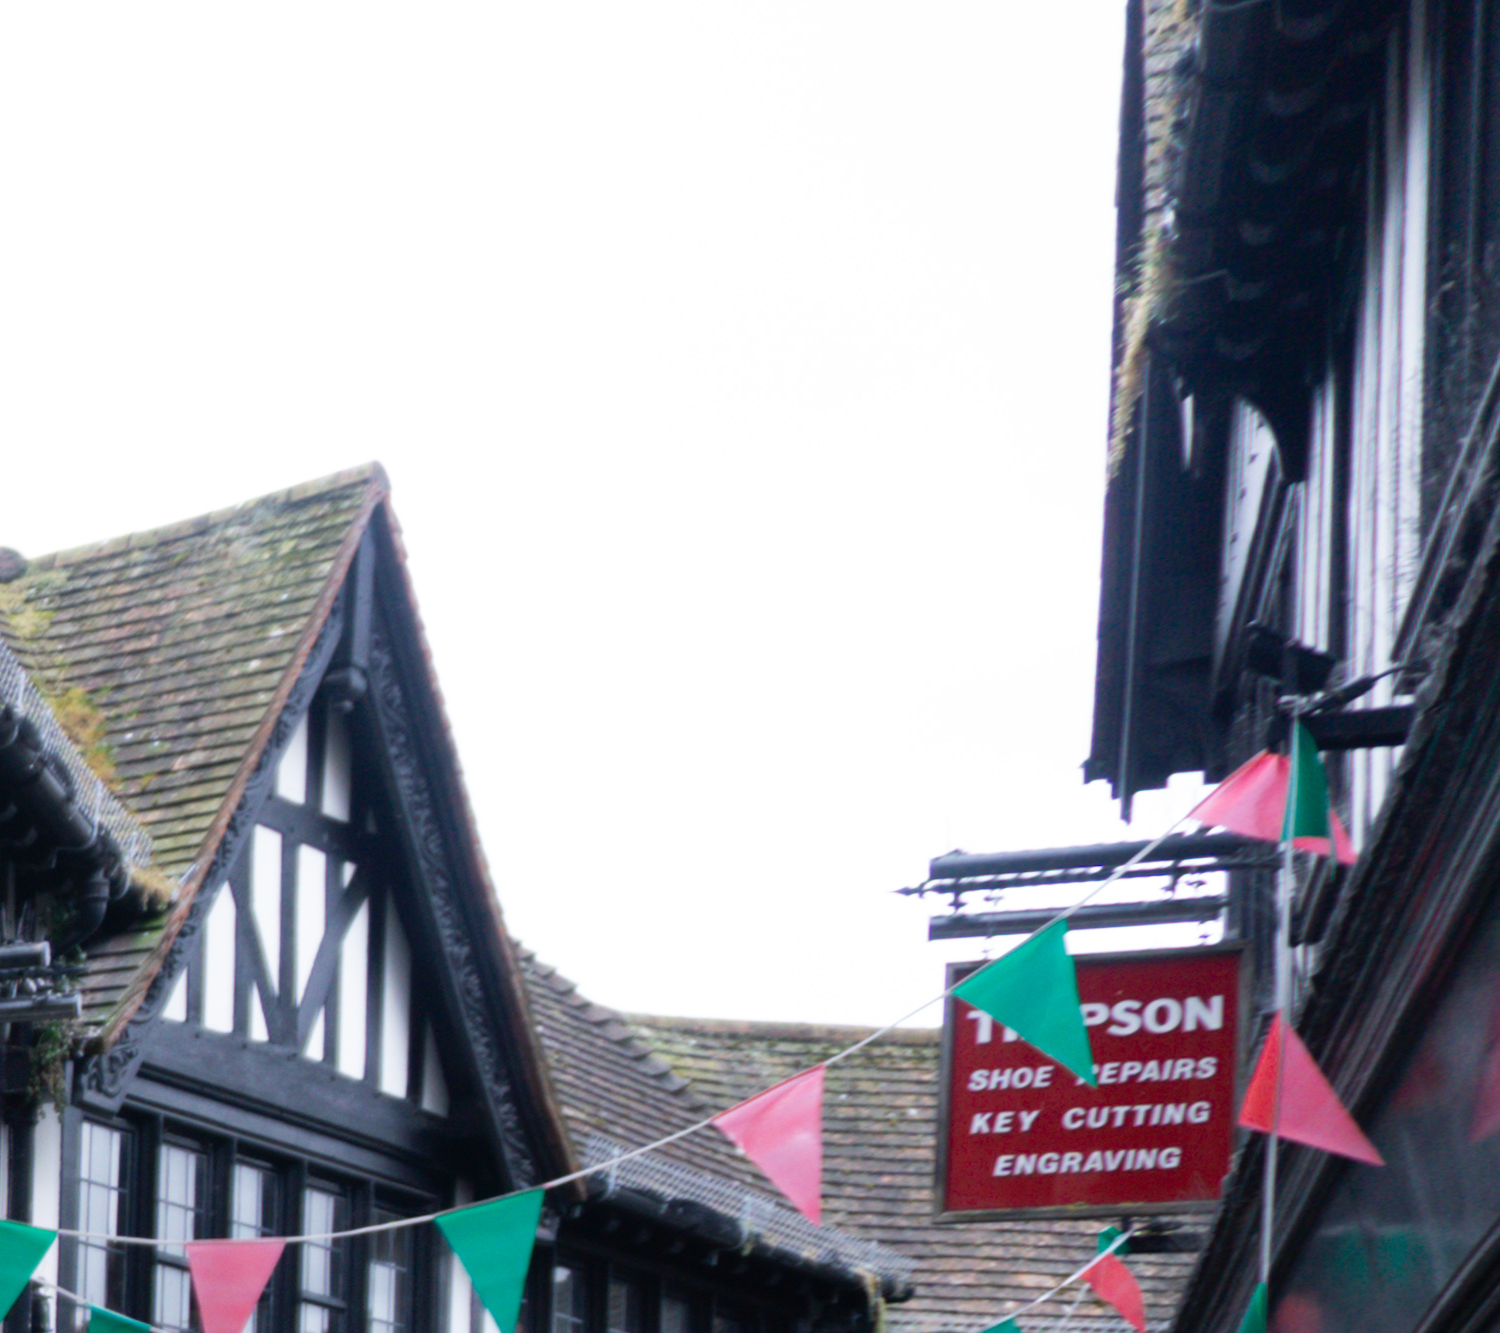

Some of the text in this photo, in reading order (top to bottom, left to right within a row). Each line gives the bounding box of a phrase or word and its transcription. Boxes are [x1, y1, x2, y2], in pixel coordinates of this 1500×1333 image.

[966, 995, 1224, 1044] TPSON
[967, 1066, 1054, 1092] SHOE
[969, 1101, 1212, 1134] KEY CUTTING
[992, 1147, 1182, 1177] ENGRAVING
